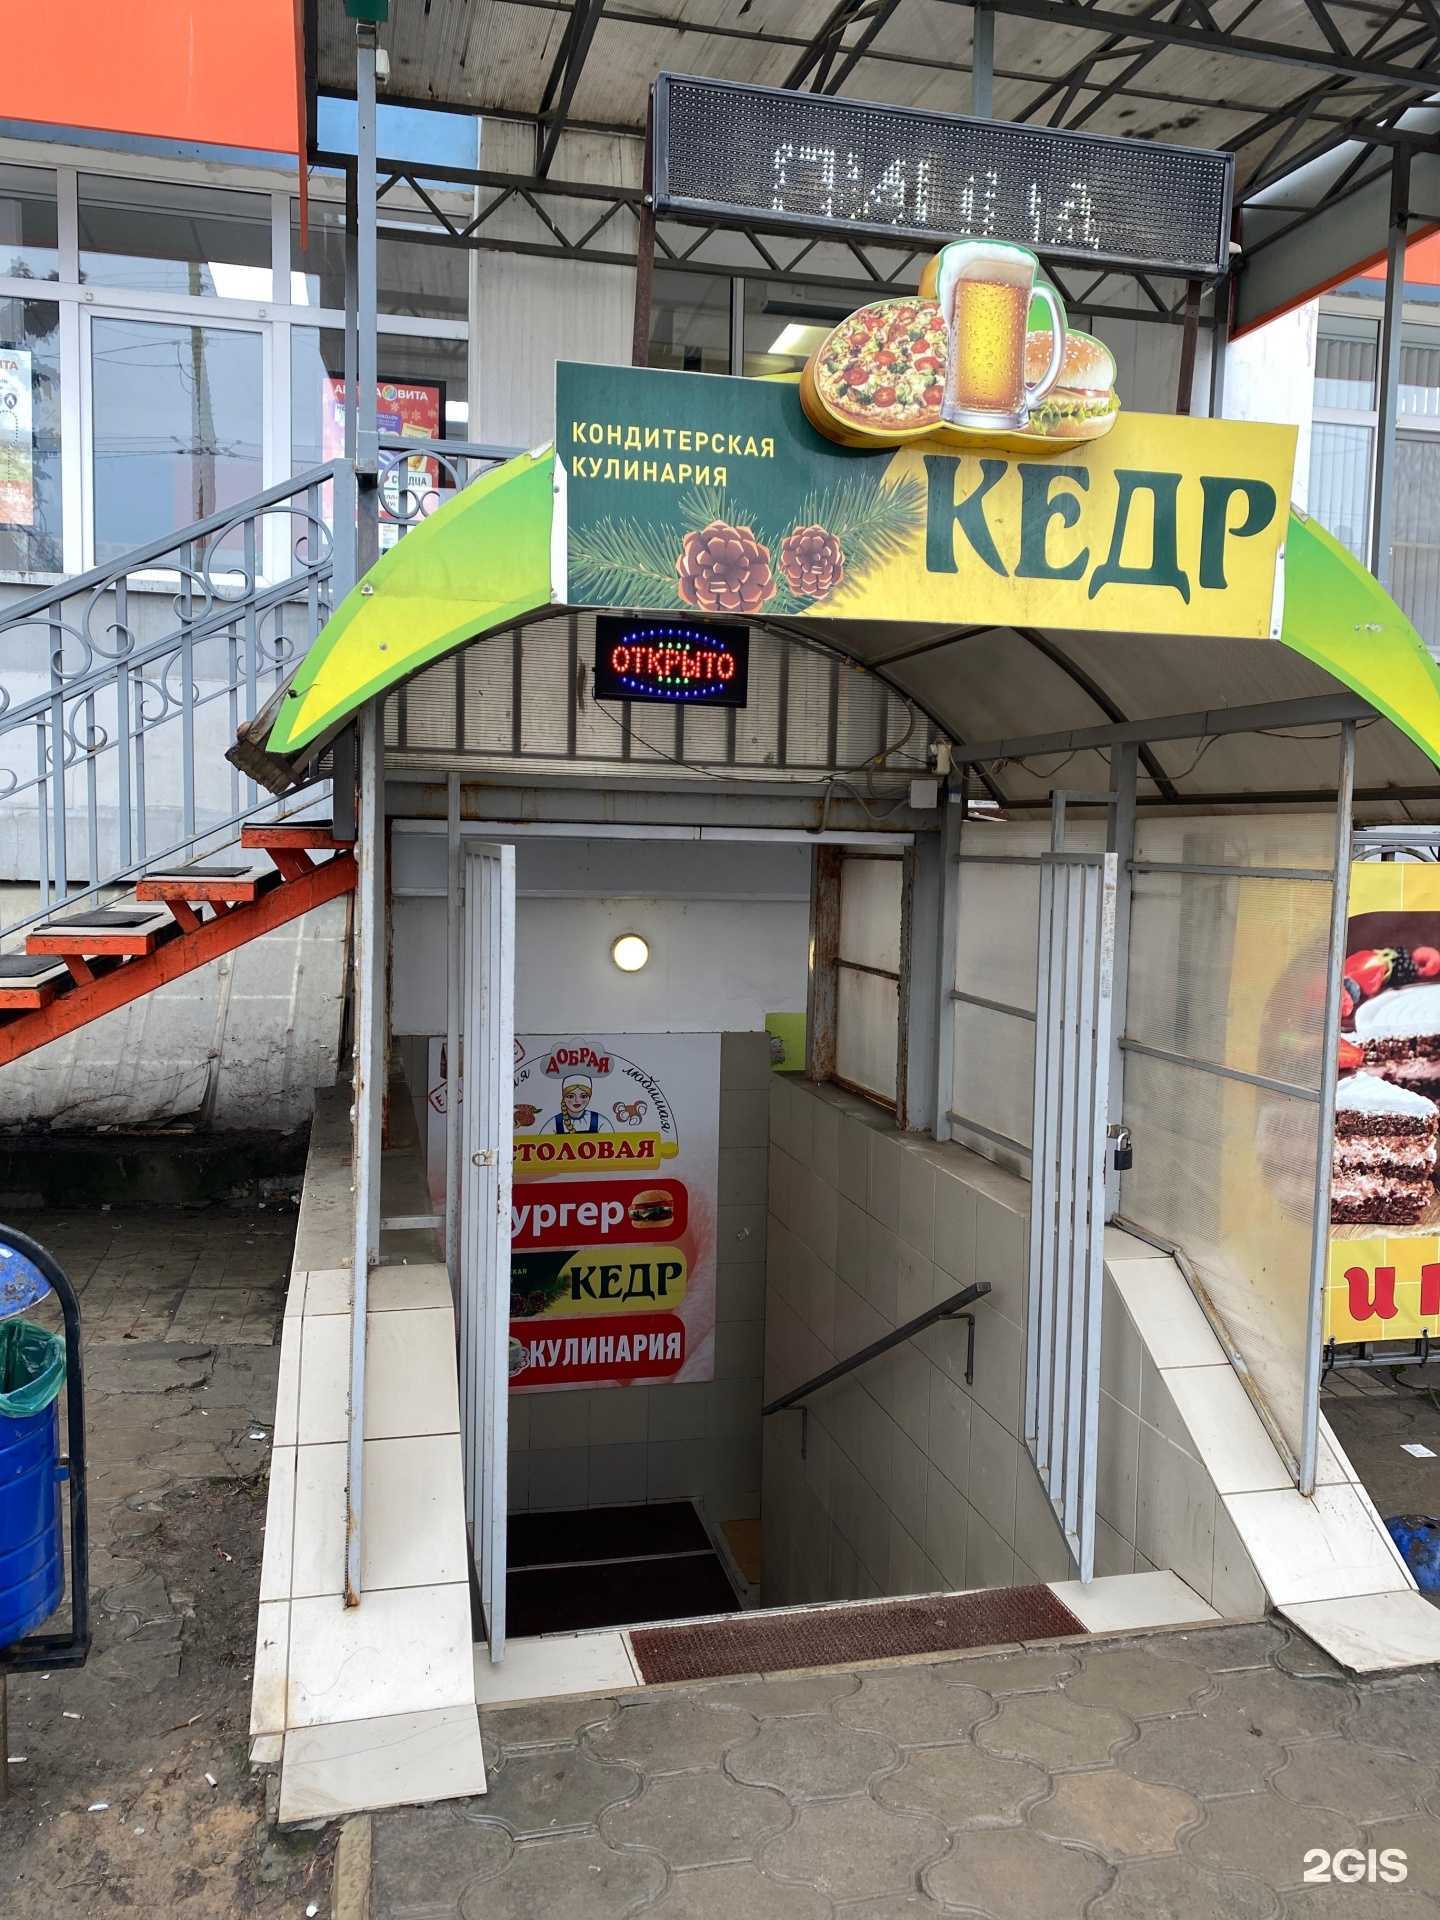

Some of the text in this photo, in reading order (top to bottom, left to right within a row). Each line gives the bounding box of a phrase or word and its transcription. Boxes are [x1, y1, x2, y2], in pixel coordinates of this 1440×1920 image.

[398, 389, 428, 401] ВИТА
[572, 421, 775, 458] КОНДИТЕРСКАЯ
[391, 474, 427, 486] СДЦА
[572, 456, 727, 487] КУЛИНАРИЯ
[923, 454, 1277, 605] КЕДР
[612, 646, 735, 679] ОТКРЫТО
[545, 1048, 610, 1074] ДОБРАЯ
[622, 1067, 671, 1133] любимая
[511, 1201, 624, 1238] ургер
[570, 1262, 682, 1302] КЕДР
[529, 1332, 681, 1367] КУЛИНАРИЯ
